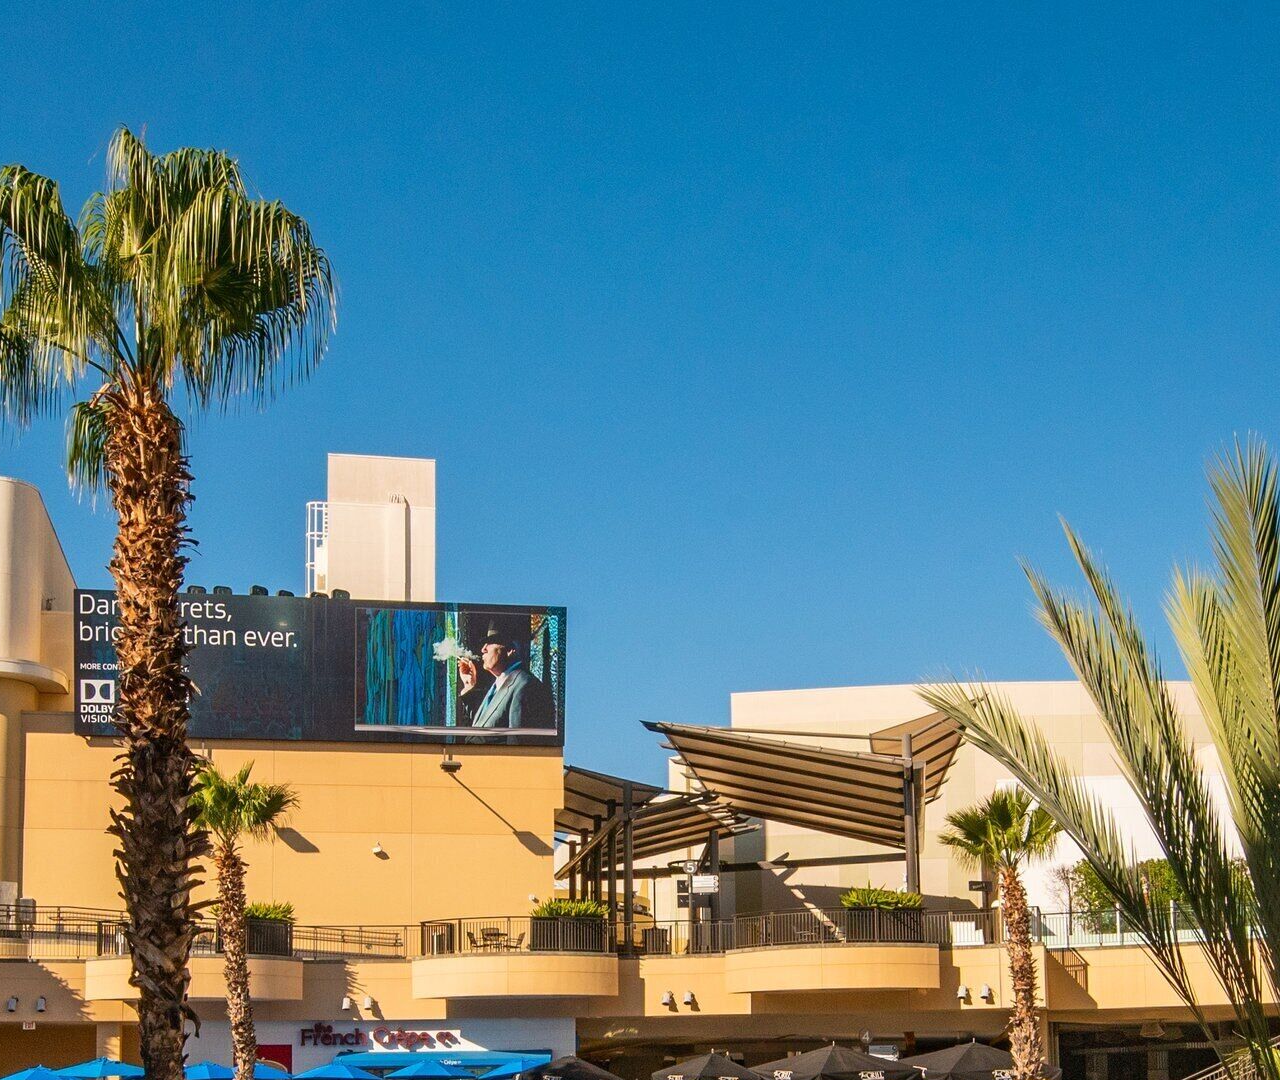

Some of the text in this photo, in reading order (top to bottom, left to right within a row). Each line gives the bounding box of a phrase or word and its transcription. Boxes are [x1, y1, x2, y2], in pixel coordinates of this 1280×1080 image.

[80, 594, 118, 615] Dar
[183, 625, 236, 646] than
[244, 631, 298, 648] ever.
[80, 704, 115, 714] DOLBY
[300, 1028, 367, 1046] French
